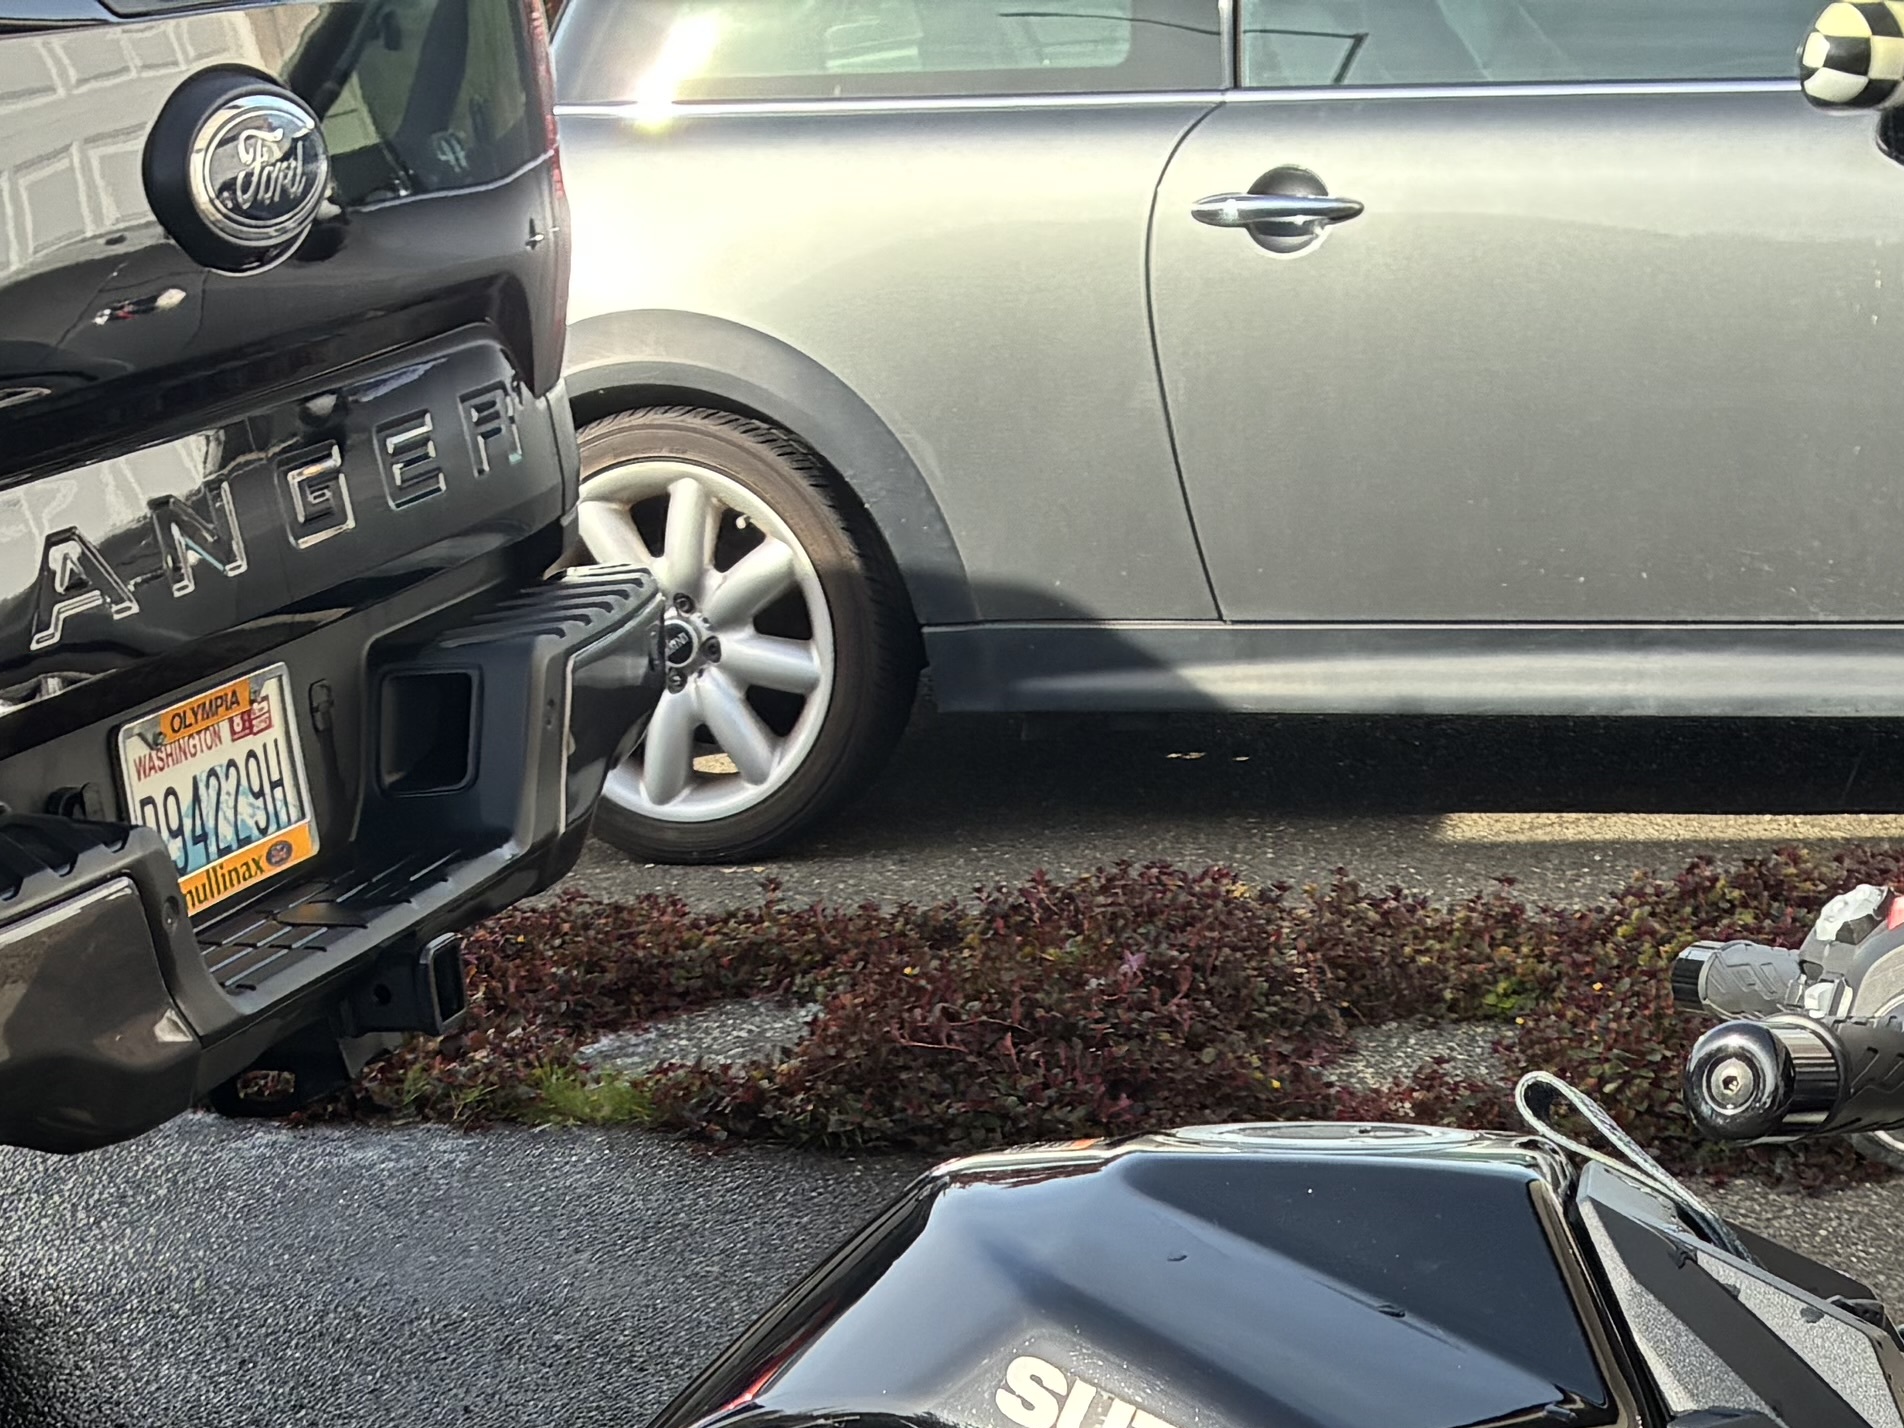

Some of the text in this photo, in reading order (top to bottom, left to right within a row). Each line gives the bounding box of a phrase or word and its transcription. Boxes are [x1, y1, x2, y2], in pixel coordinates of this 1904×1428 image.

[235, 127, 308, 210] Ford
[169, 689, 241, 734] OLYMPIA
[133, 723, 223, 782] WASHINGTON
